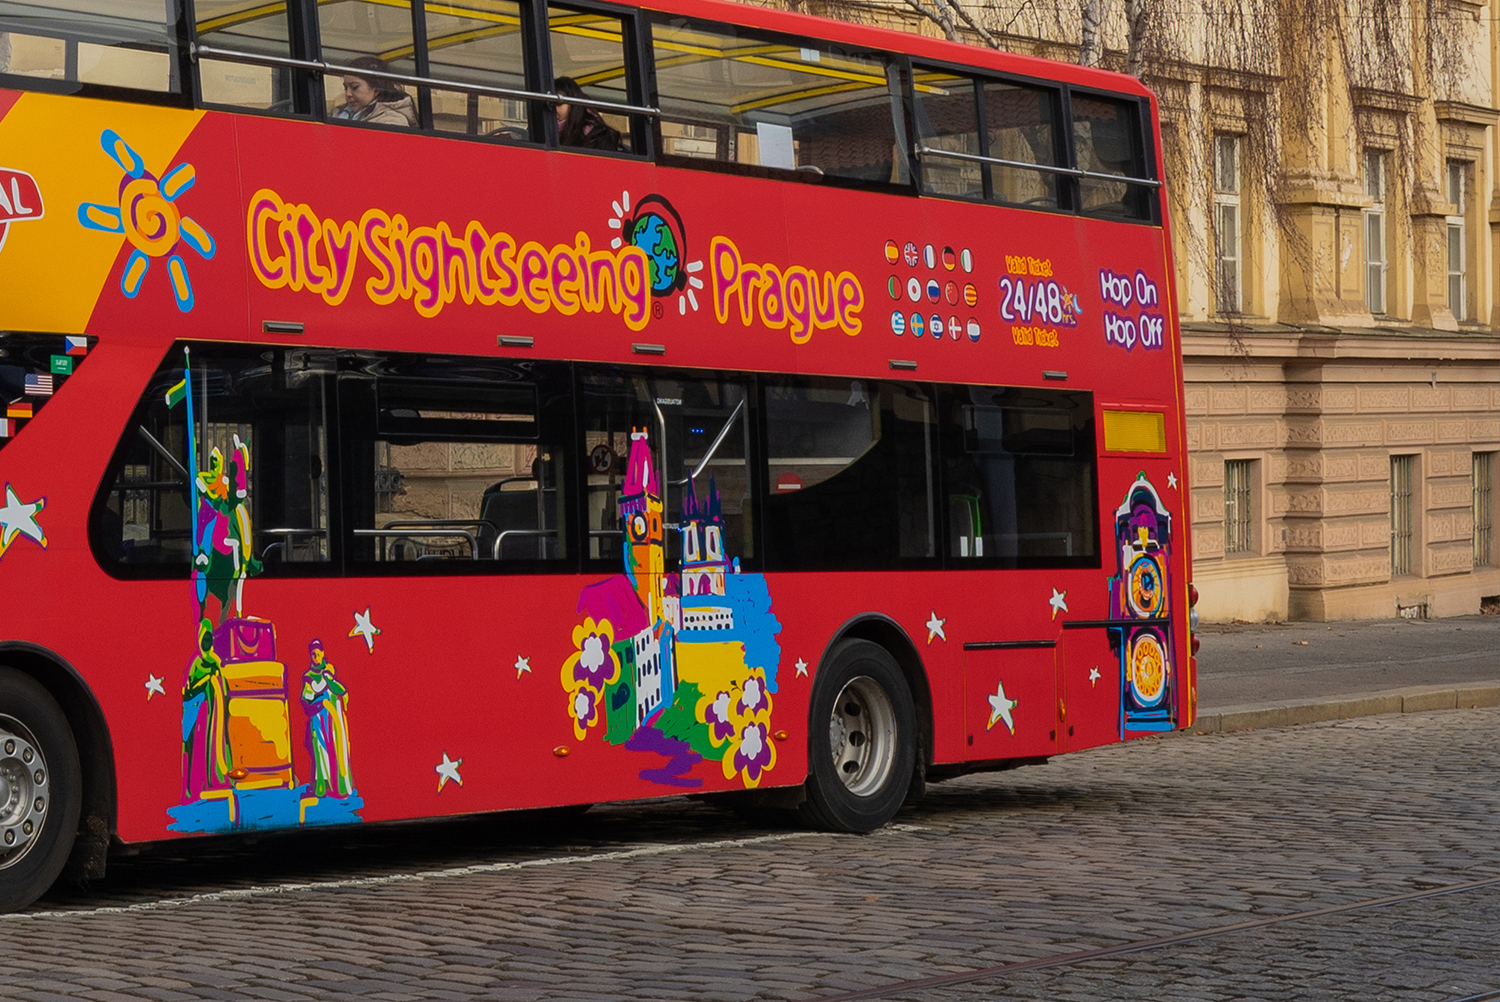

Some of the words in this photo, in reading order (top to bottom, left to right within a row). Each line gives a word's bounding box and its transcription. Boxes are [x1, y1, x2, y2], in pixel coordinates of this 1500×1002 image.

[1005, 255, 1027, 276] Valid
[1027, 256, 1053, 278] Ticket
[710, 235, 865, 345] Prague
[1000, 278, 1062, 324] 24/48
[1100, 271, 1132, 307] Hop
[1135, 273, 1158, 306] On
[1012, 326, 1033, 347] Valid
[1033, 327, 1060, 348] Ticket
[1105, 313, 1137, 349] Hop
[1139, 315, 1163, 348] Off
